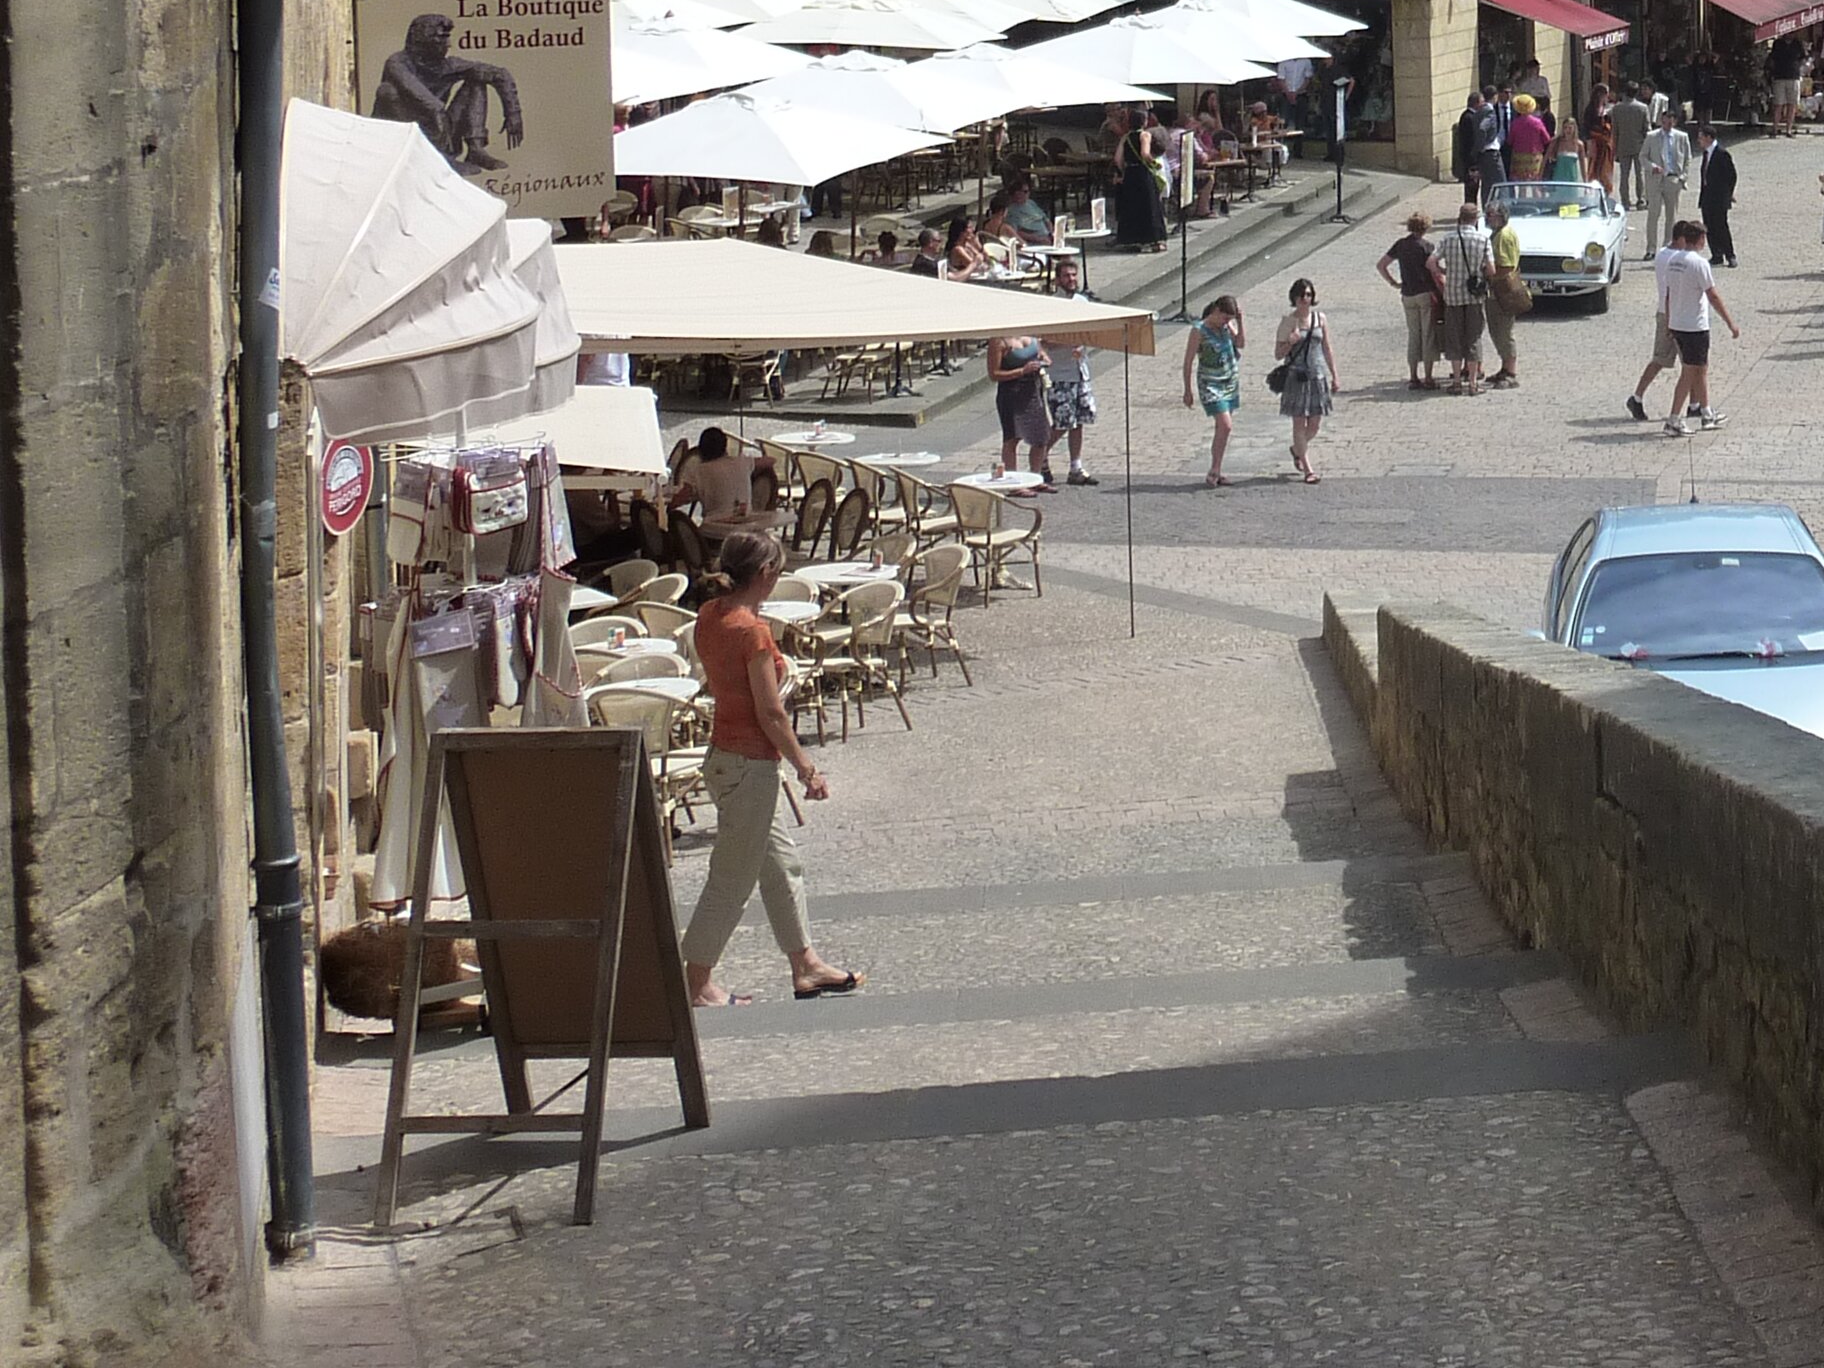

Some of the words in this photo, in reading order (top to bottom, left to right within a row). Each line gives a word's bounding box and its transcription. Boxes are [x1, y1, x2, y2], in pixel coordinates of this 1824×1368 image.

[458, 30, 487, 50] du
[494, 26, 585, 49] Badaud
[485, 172, 606, 208] Régionaux
